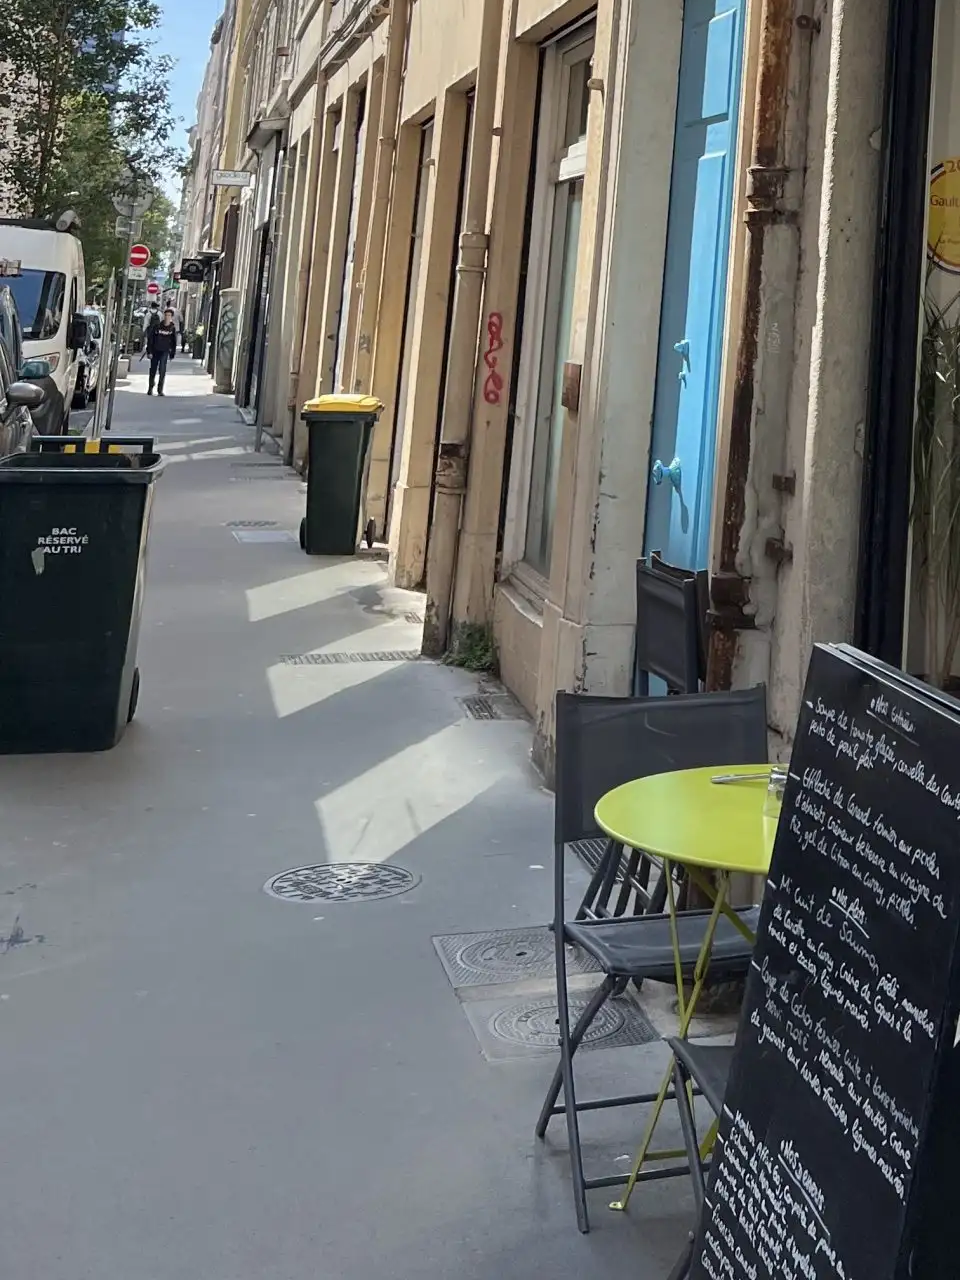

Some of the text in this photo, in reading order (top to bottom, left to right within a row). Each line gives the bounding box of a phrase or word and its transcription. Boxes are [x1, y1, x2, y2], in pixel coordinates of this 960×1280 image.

[37, 534, 89, 545] RÉSERVÉ
[52, 527, 77, 536] BAC
[43, 545, 82, 554] AU TRI
[808, 719, 825, 737] pesto
[826, 727, 835, 746] de
[815, 697, 835, 722] Soupe
[837, 710, 848, 730] de
[925, 774, 940, 796] des
[833, 786, 843, 809] de
[898, 839, 912, 856] aux
[817, 836, 827, 856] de
[851, 863, 862, 880] au
[888, 861, 898, 879] au
[932, 894, 947, 919] de
[788, 942, 798, 955] et
[816, 905, 833, 928] de
[839, 921, 879, 975] Saumon
[773, 903, 782, 921] de
[806, 938, 816, 953] au
[860, 983, 871, 1004] de
[902, 1019, 912, 1043] la
[779, 981, 789, 1003] de
[750, 1008, 760, 1027] de
[786, 1046, 800, 1070] aux
[847, 1082, 862, 1106] aux
[807, 1220, 816, 1240] de
